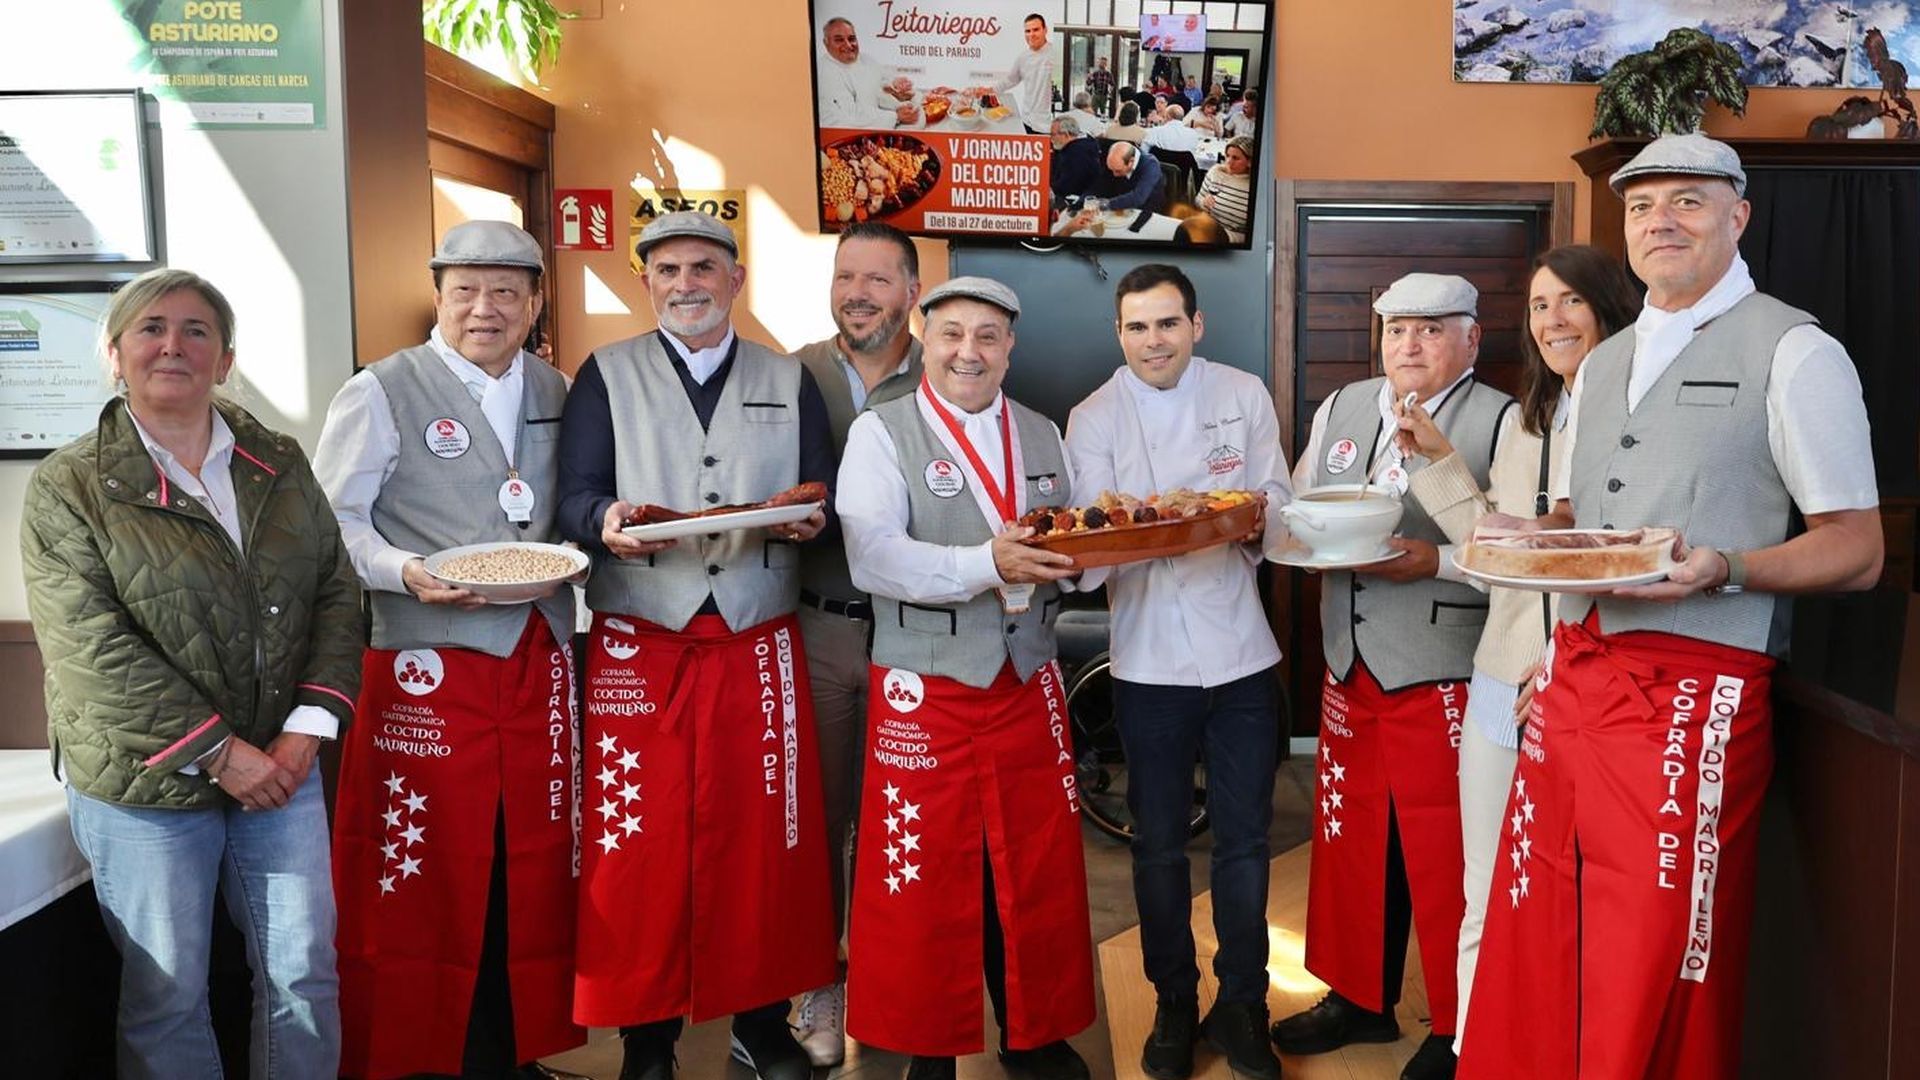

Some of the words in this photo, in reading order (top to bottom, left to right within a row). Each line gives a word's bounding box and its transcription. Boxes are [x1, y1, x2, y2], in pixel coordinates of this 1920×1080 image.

[184, 1, 242, 20] POTE
[150, 23, 279, 43] ASTURIANO
[876, 0, 1002, 45] Leitariegos
[900, 45, 926, 56] TECHO
[928, 46, 944, 57] DEL
[172, 75, 216, 87] ASTURIANO
[218, 75, 229, 87] DE
[229, 75, 261, 87] CANGAS
[263, 75, 276, 87] DEL
[278, 75, 309, 87] NARCEA
[949, 138, 959, 158] V
[962, 139, 1044, 162] JORNADAS
[951, 163, 980, 183] DEL
[983, 164, 1041, 186] COCIDO
[635, 198, 740, 221] ASEOS
[951, 186, 1041, 210] MADRILEÑO
[930, 215, 946, 227] Del
[947, 216, 957, 228] 18
[959, 217, 968, 228] al
[969, 217, 980, 229] 27
[981, 216, 994, 229] de
[995, 218, 1033, 231] octubre
[600, 667, 636, 677] COFRADÍA
[593, 687, 645, 700] COCIDO
[754, 637, 777, 742] OFRADÍA
[392, 703, 434, 716] COFRADÍA
[549, 652, 564, 767] COFRADÍA
[588, 700, 657, 717] MADRILEÑO
[1437, 682, 1463, 749] OFRAD
[383, 723, 442, 741] COCIDO
[884, 719, 921, 731] COFRADÍA
[1702, 685, 1736, 784] COCIDO
[371, 735, 452, 758] MADRILEÑO
[878, 737, 928, 754] COCIDO
[1659, 678, 1699, 816] COFRADÍA
[873, 746, 938, 771] MADRILEÑO
[763, 753, 778, 796] DEL
[784, 718, 797, 841] MADRILEÑO
[549, 779, 563, 821] DEL
[1062, 774, 1080, 813] DEL
[1658, 832, 1681, 890] DEL
[1686, 802, 1719, 971] MADRILEÑO
